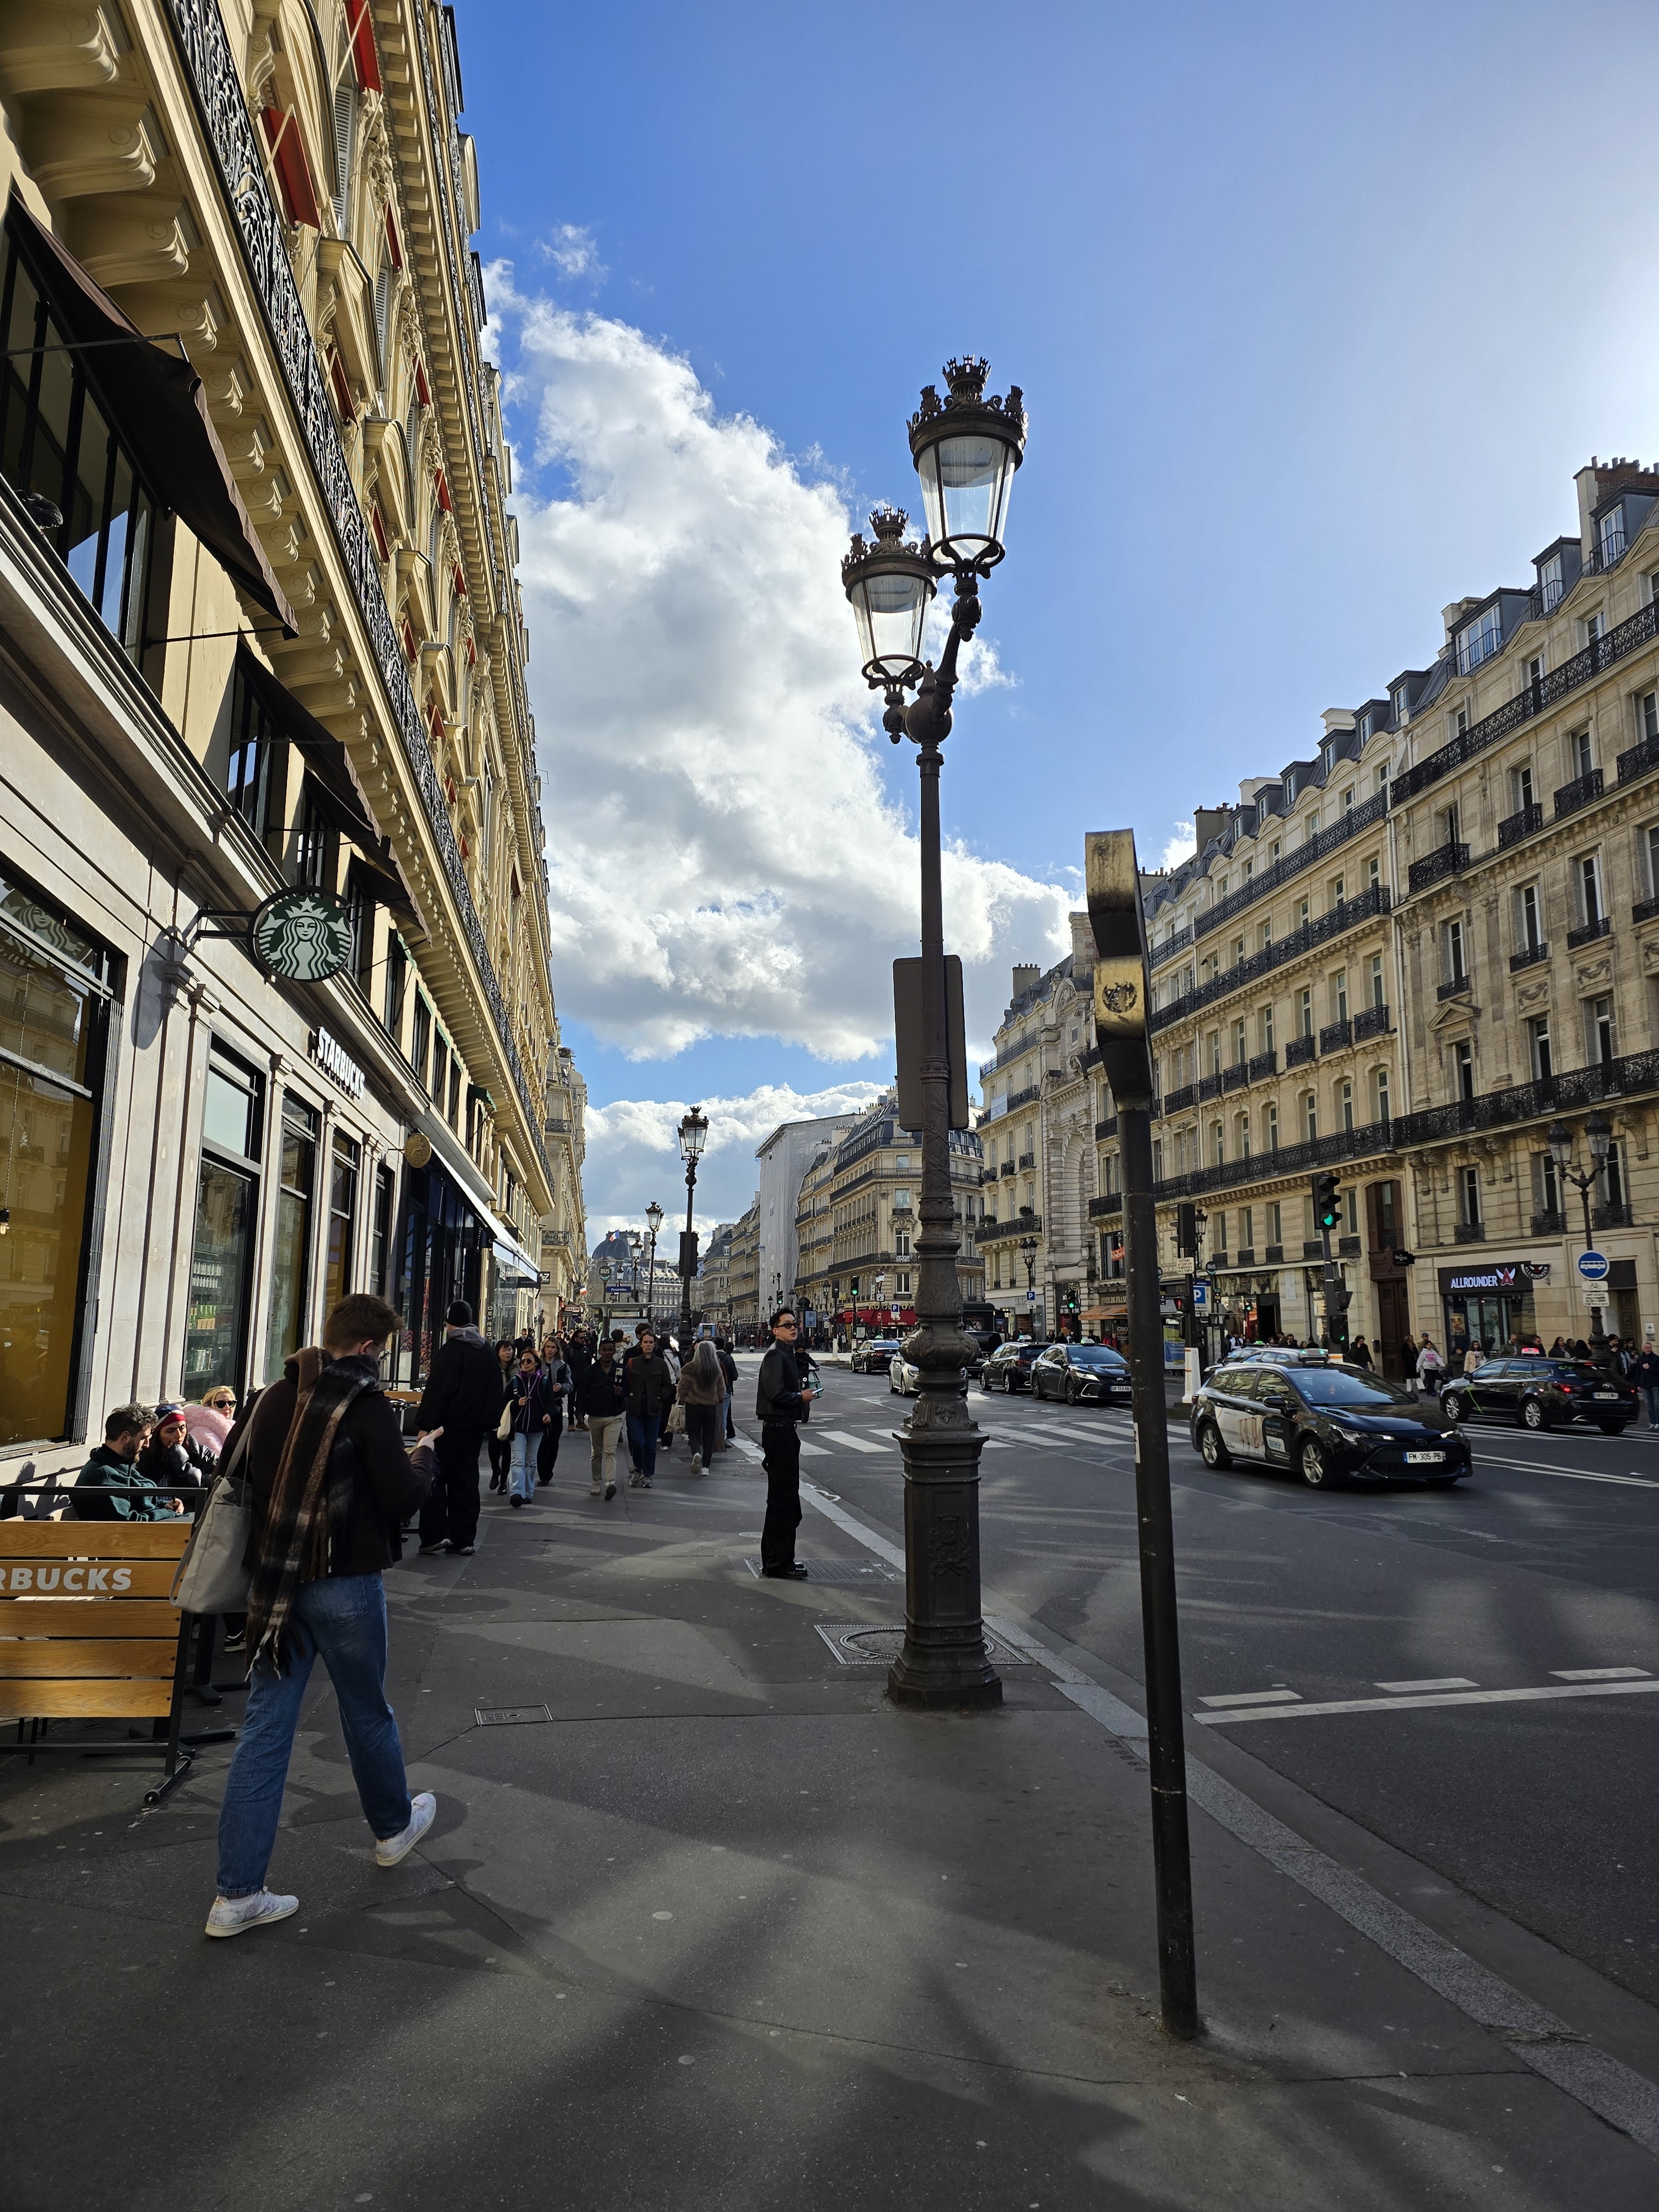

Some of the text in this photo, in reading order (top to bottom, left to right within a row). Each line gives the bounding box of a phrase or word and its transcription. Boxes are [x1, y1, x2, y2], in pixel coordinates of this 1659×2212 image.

[317, 1026, 365, 1100] STARBUCKS
[1451, 1275, 1498, 1289] ALLROUNDER
[1193, 1289, 1202, 1301] P
[1408, 1452, 1442, 1461] FM-305-PB
[0, 1568, 133, 1591] BUCKS
